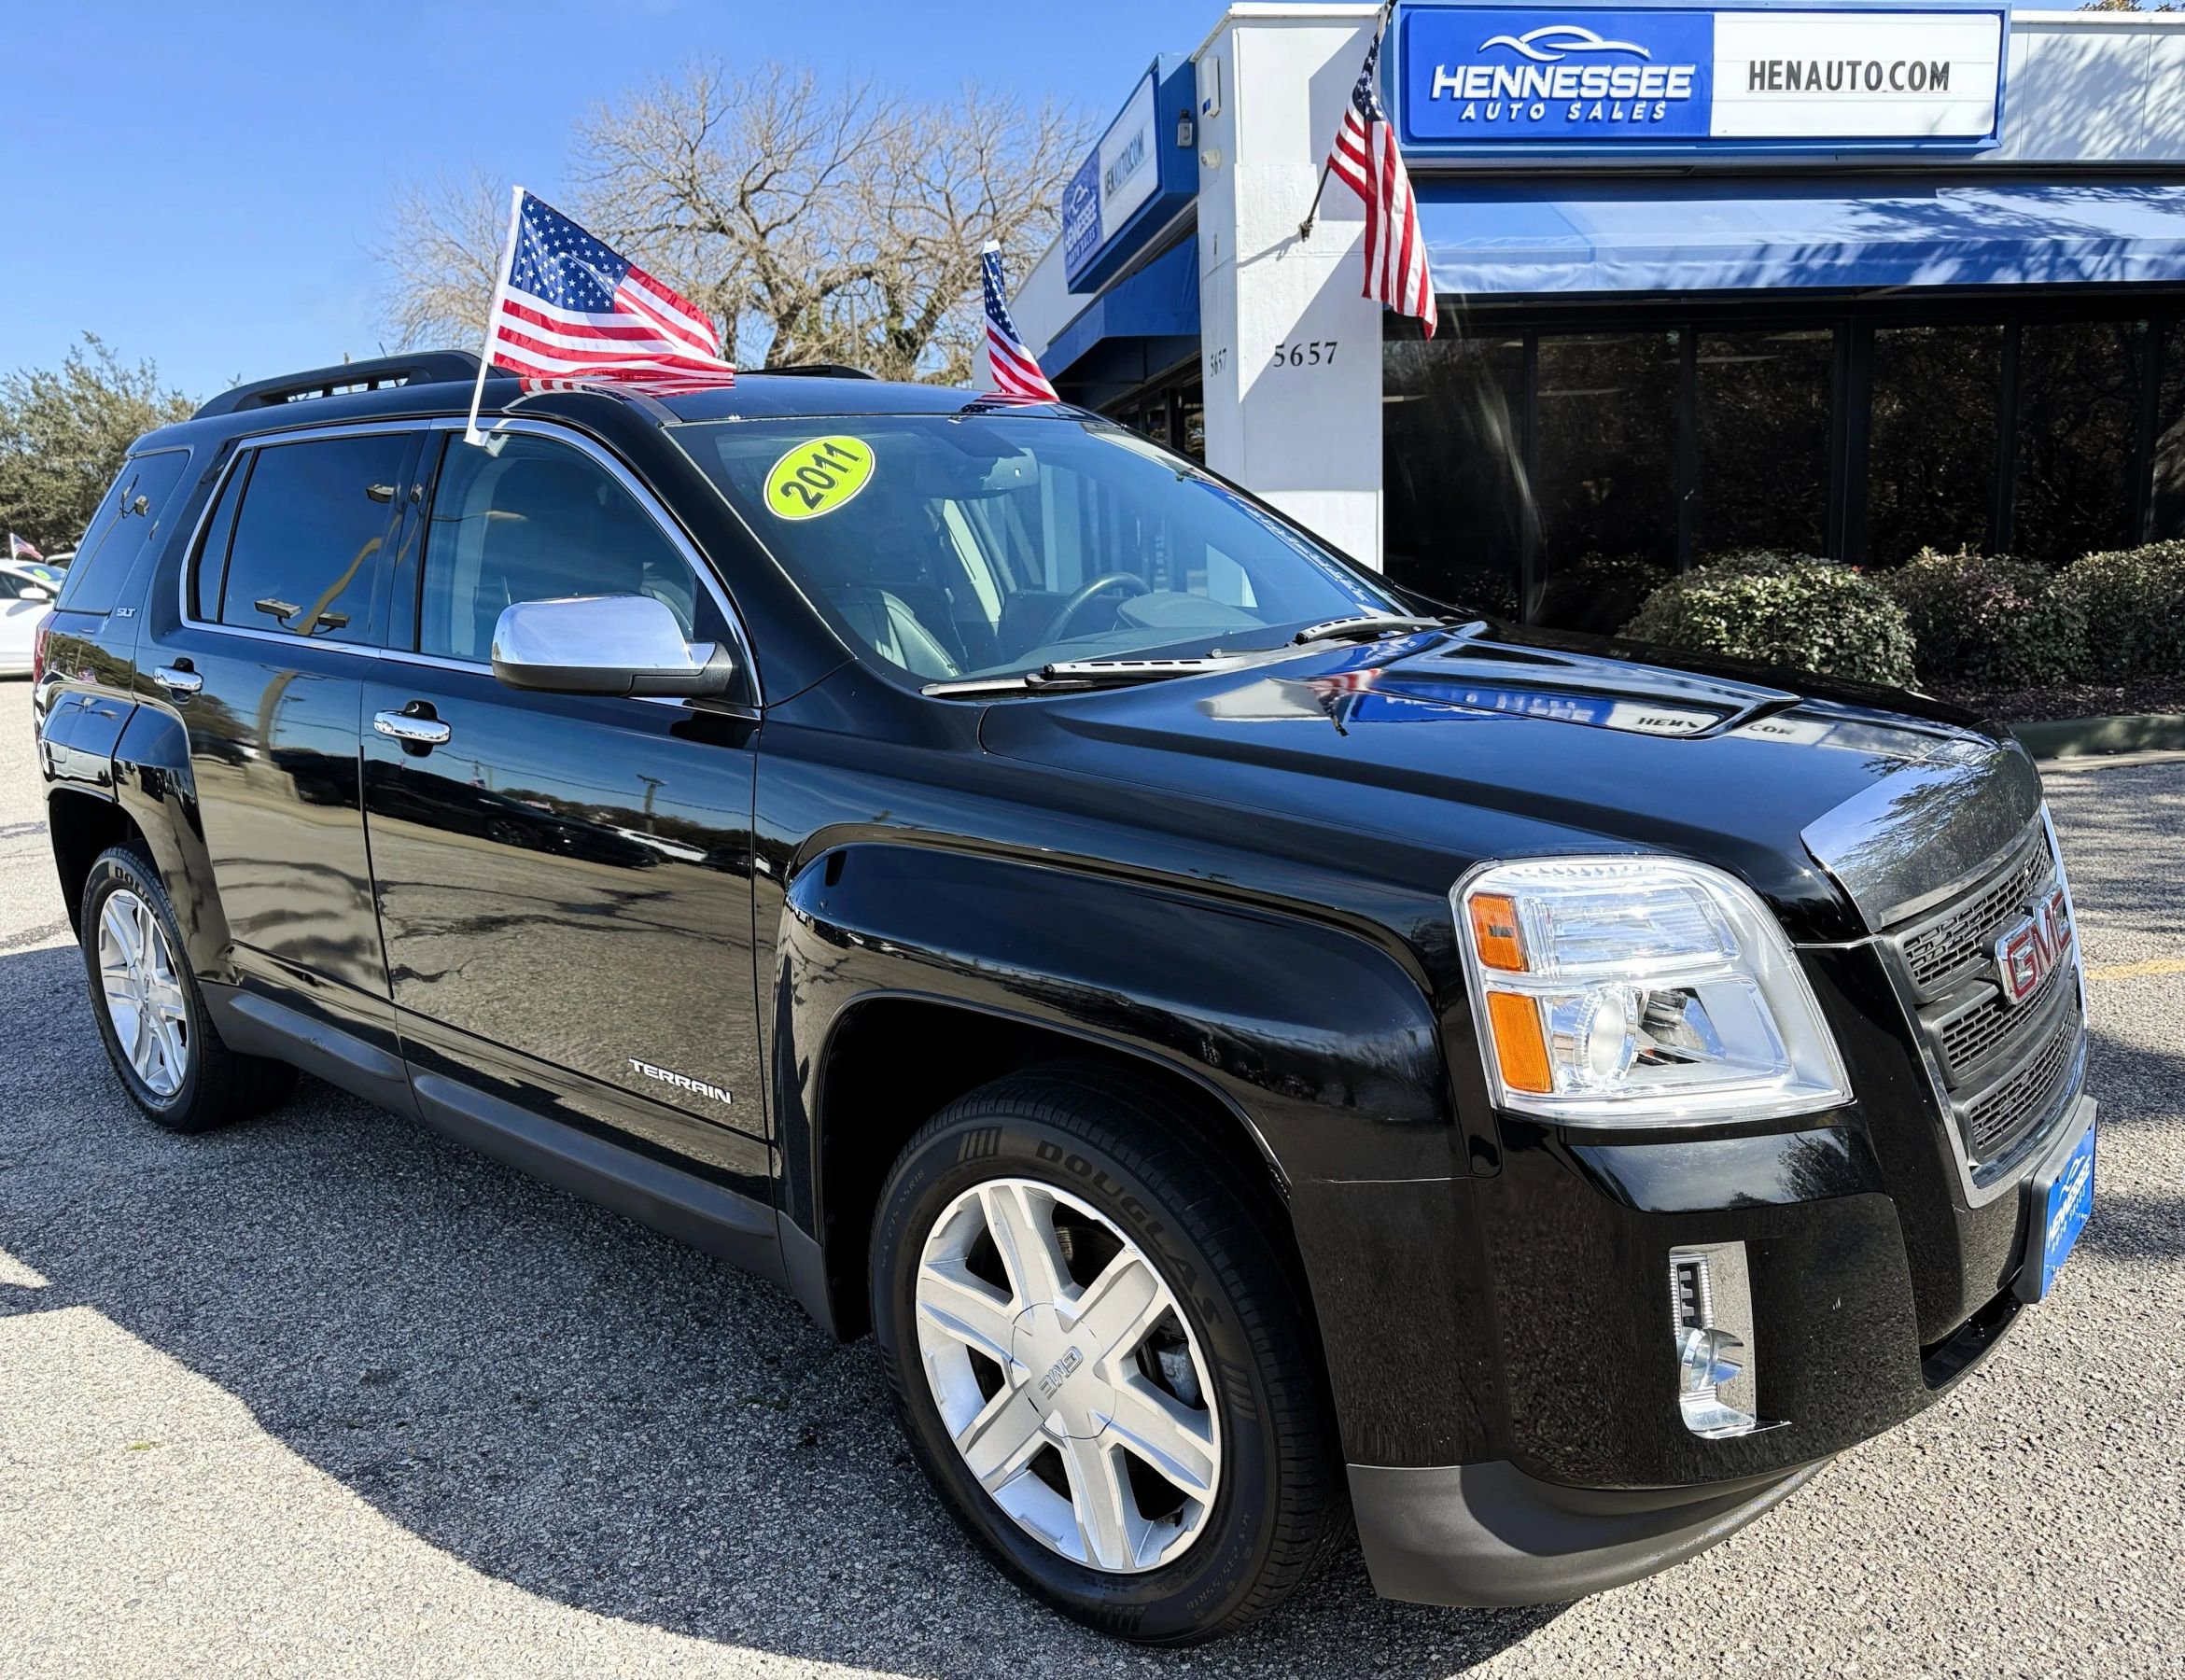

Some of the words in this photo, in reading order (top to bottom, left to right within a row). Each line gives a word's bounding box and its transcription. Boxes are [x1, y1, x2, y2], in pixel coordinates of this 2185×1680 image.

[1431, 64, 1696, 99] HENNESSEE
[1748, 60, 1951, 93] HENAUTO.COM
[1461, 102, 1546, 120] AUTO
[1568, 101, 1666, 120] SALES
[1273, 341, 1338, 368] 5657
[780, 442, 862, 510] 2011
[117, 608, 136, 617] SLT
[1996, 886, 2072, 1004] GMC
[628, 1057, 732, 1105] TERRAIN
[1035, 1140, 1224, 1325] DOUGLAS
[1038, 1346, 1084, 1400] GMC
[1186, 1546, 1240, 1612] 235/55R18
